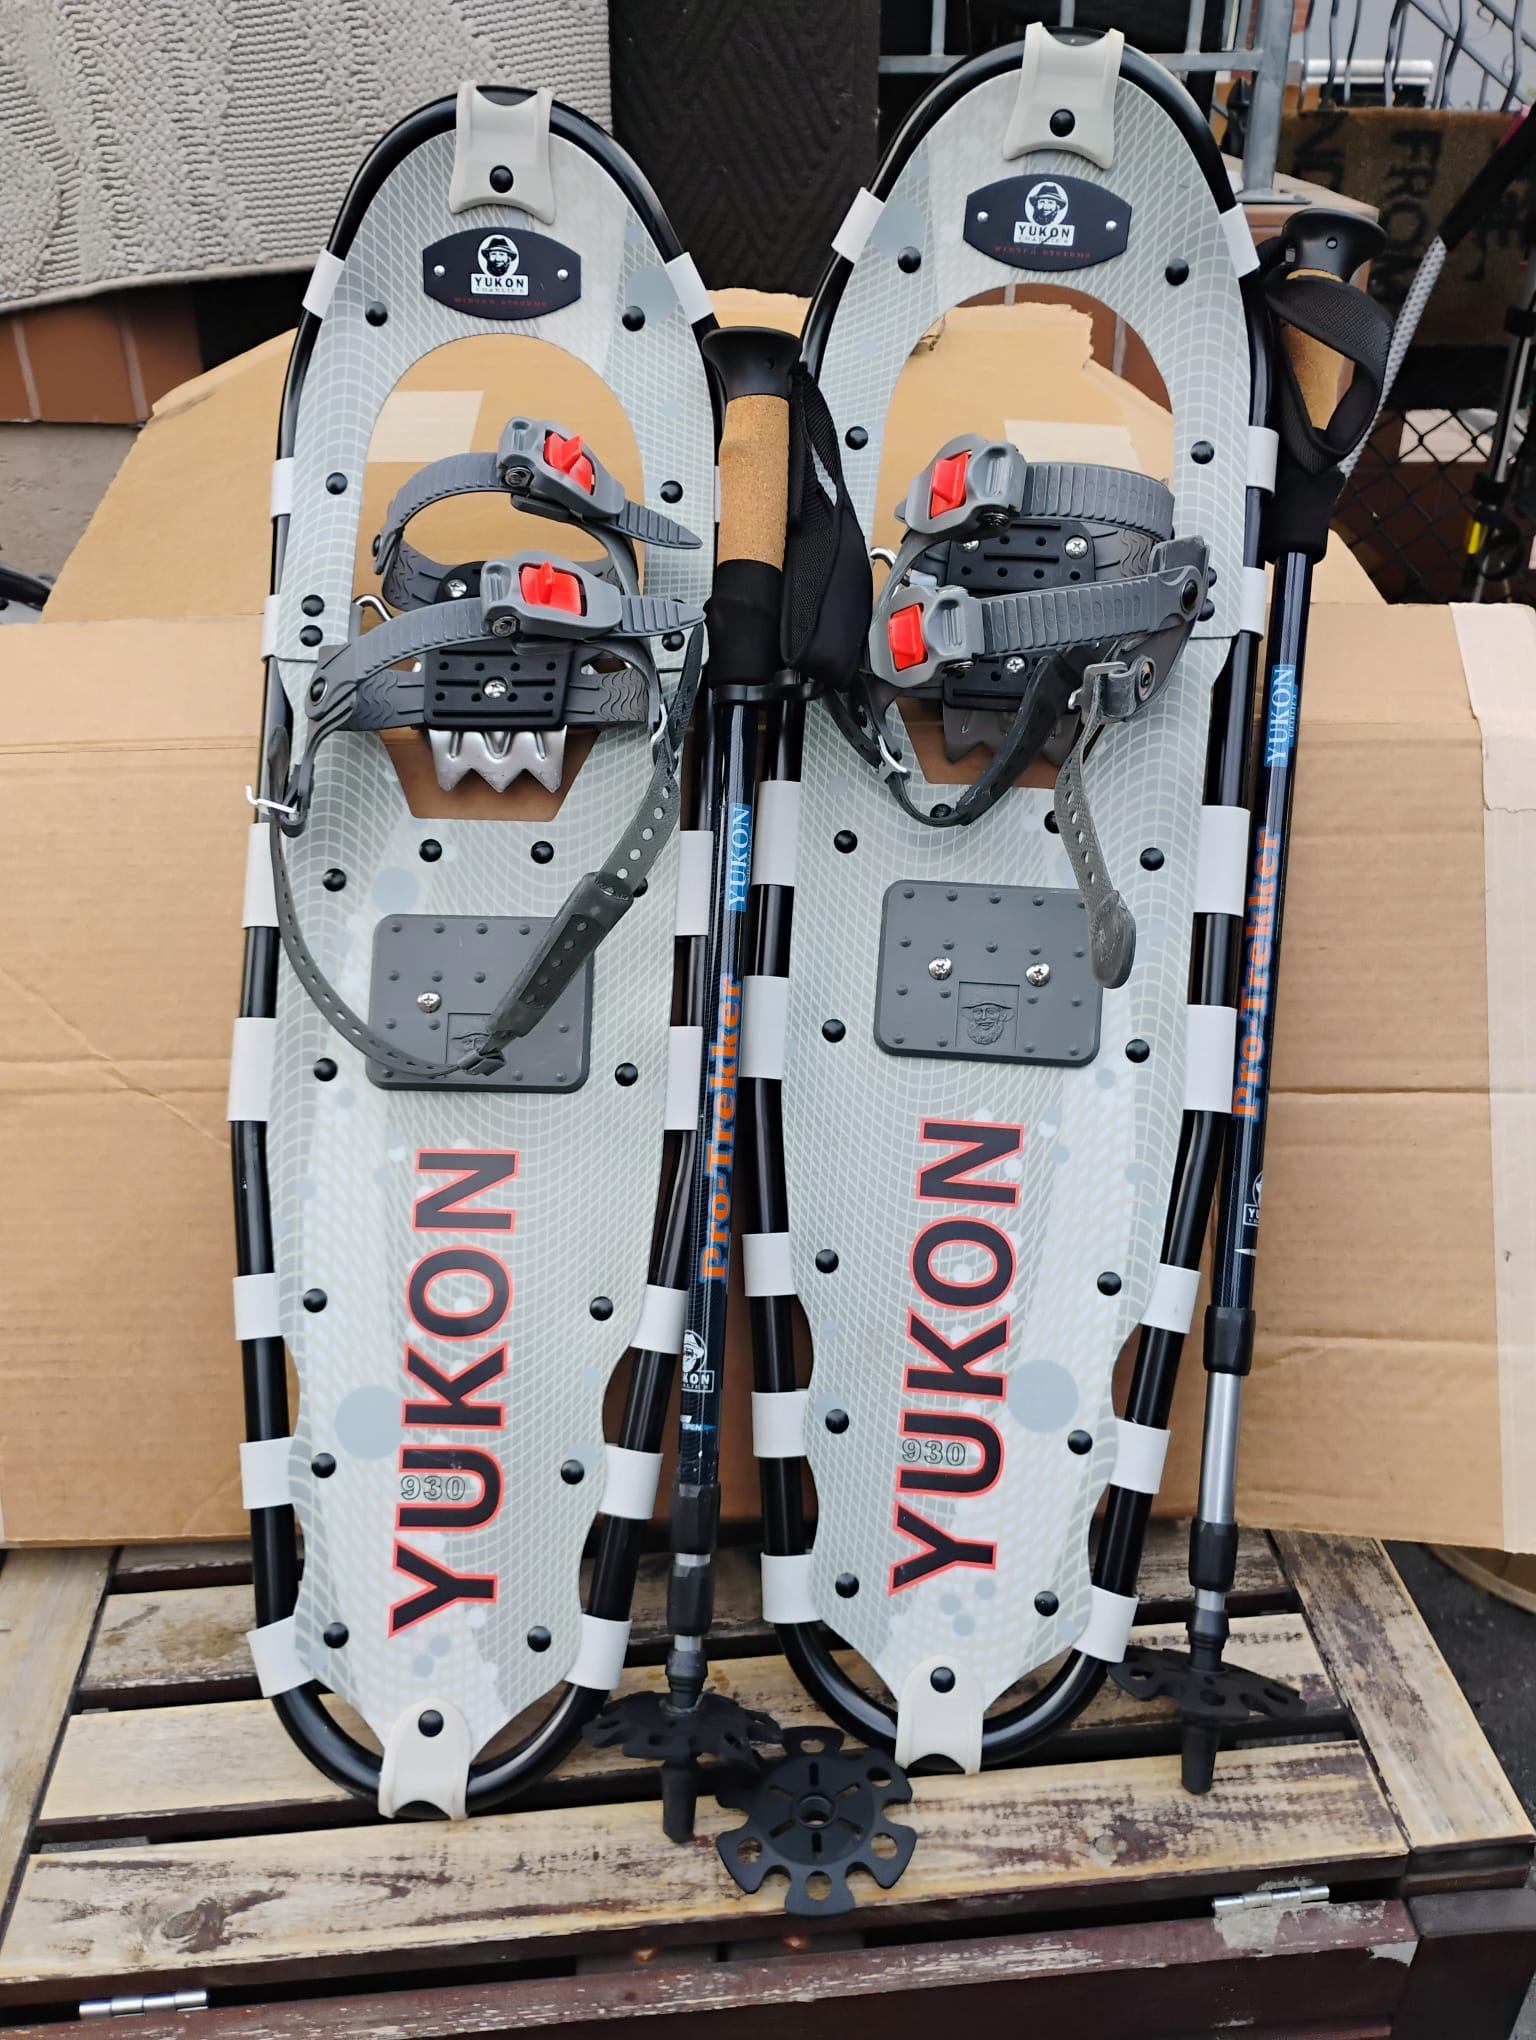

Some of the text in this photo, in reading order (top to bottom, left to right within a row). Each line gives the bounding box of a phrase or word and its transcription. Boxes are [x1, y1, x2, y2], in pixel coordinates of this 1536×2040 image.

[1018, 225, 1070, 238] YUKON
[475, 276, 525, 288] YUKON
[1266, 668, 1293, 766] YUKON
[728, 807, 750, 906] YUKON
[1231, 828, 1280, 1119] Pro-Trekker
[701, 975, 742, 1281] Pro-Trekker
[388, 1149, 519, 1639] YUKON
[682, 1373, 710, 1385] KON
[888, 1118, 1024, 1596] YUKON
[400, 1474, 466, 1501] 930
[902, 1438, 966, 1467] 930
